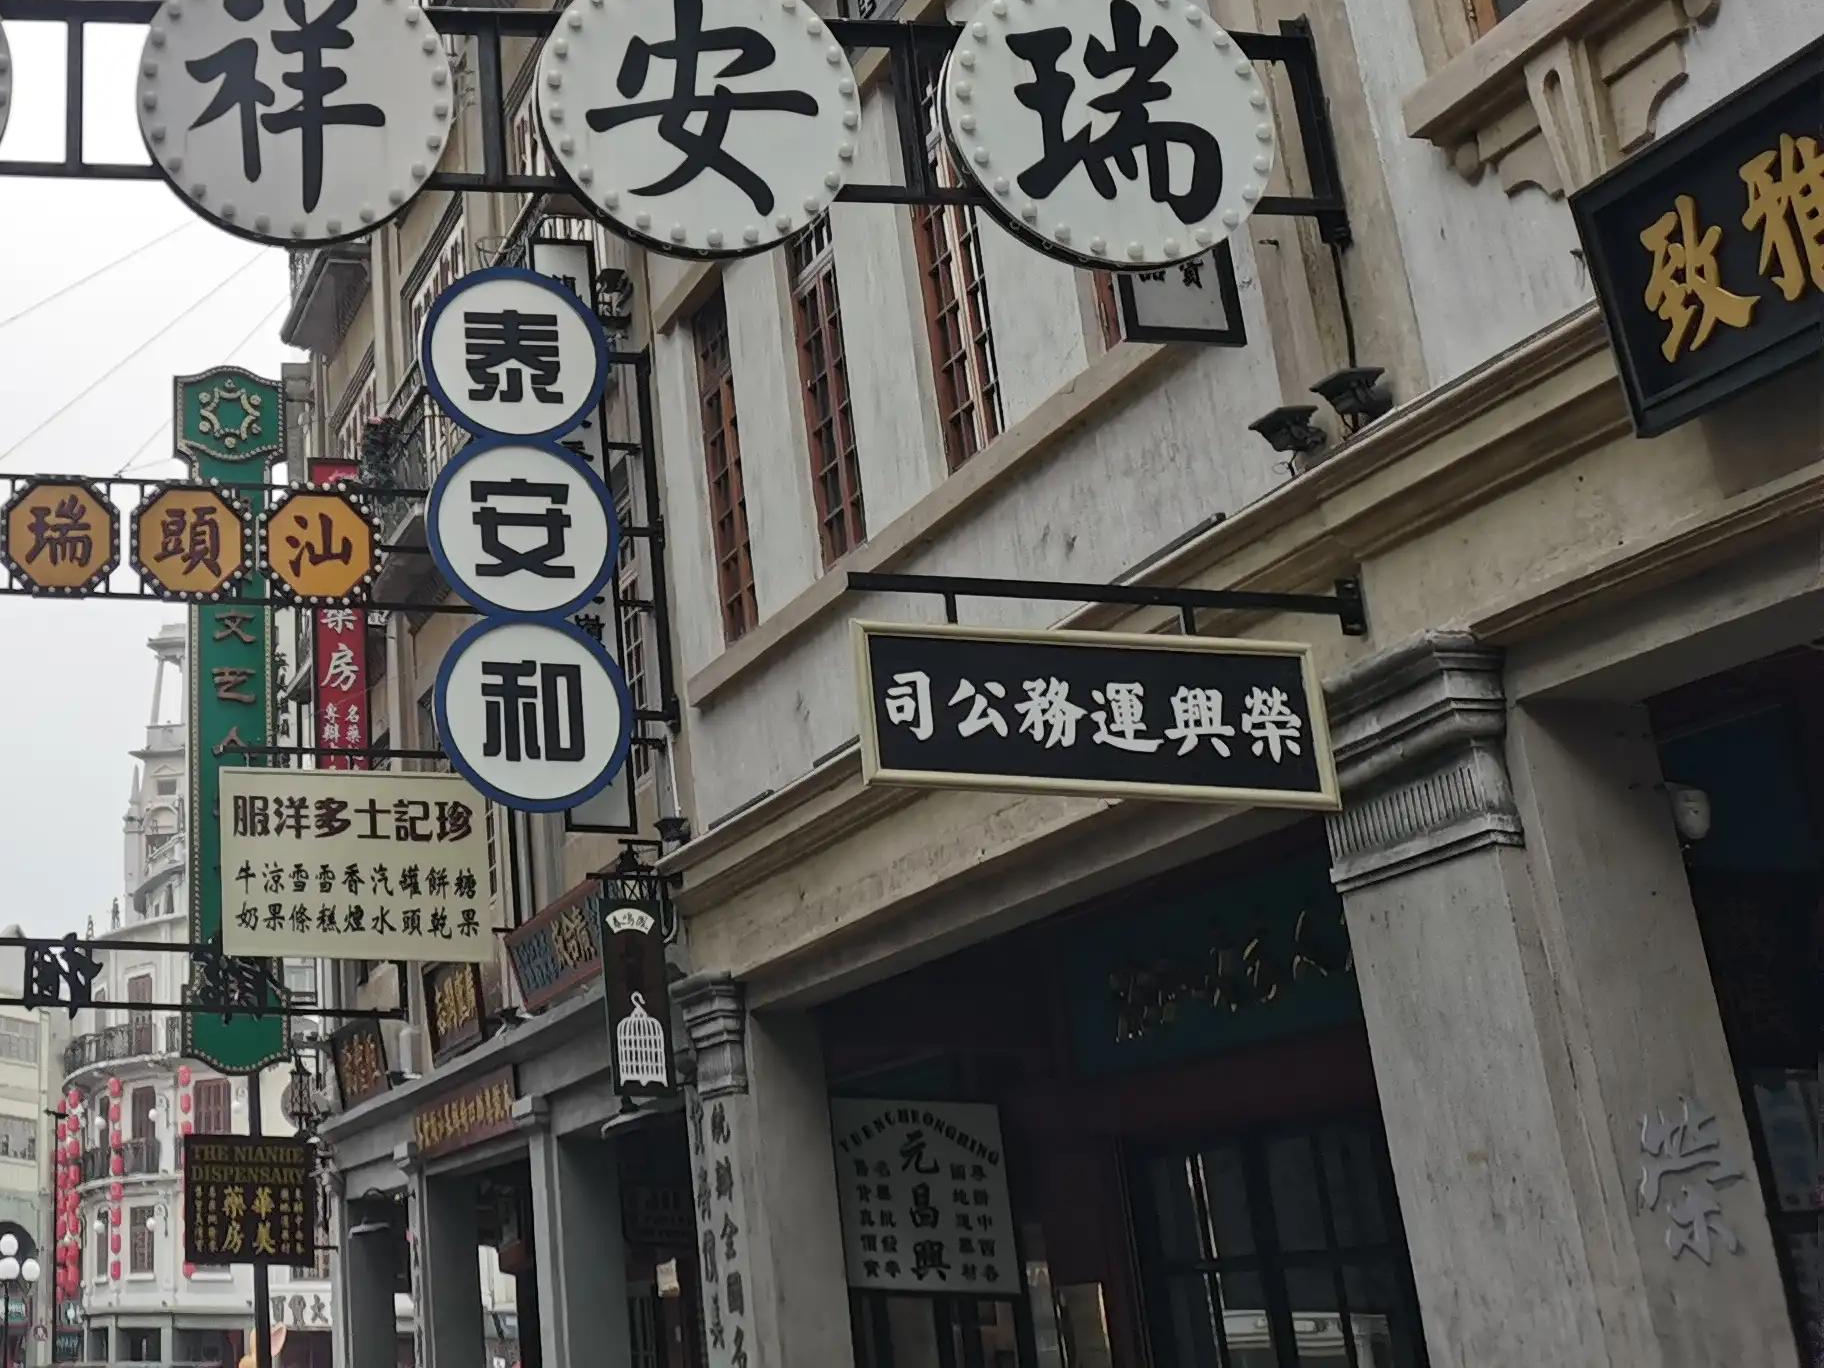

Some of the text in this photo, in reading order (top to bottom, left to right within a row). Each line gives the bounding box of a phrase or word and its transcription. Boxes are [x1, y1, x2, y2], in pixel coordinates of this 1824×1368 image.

[463, 309, 586, 763] 泰安和
[190, 1164, 306, 1184] DISPENSARY
[191, 1143, 227, 1162] THE
[898, 1131, 951, 1282] 元昌興
